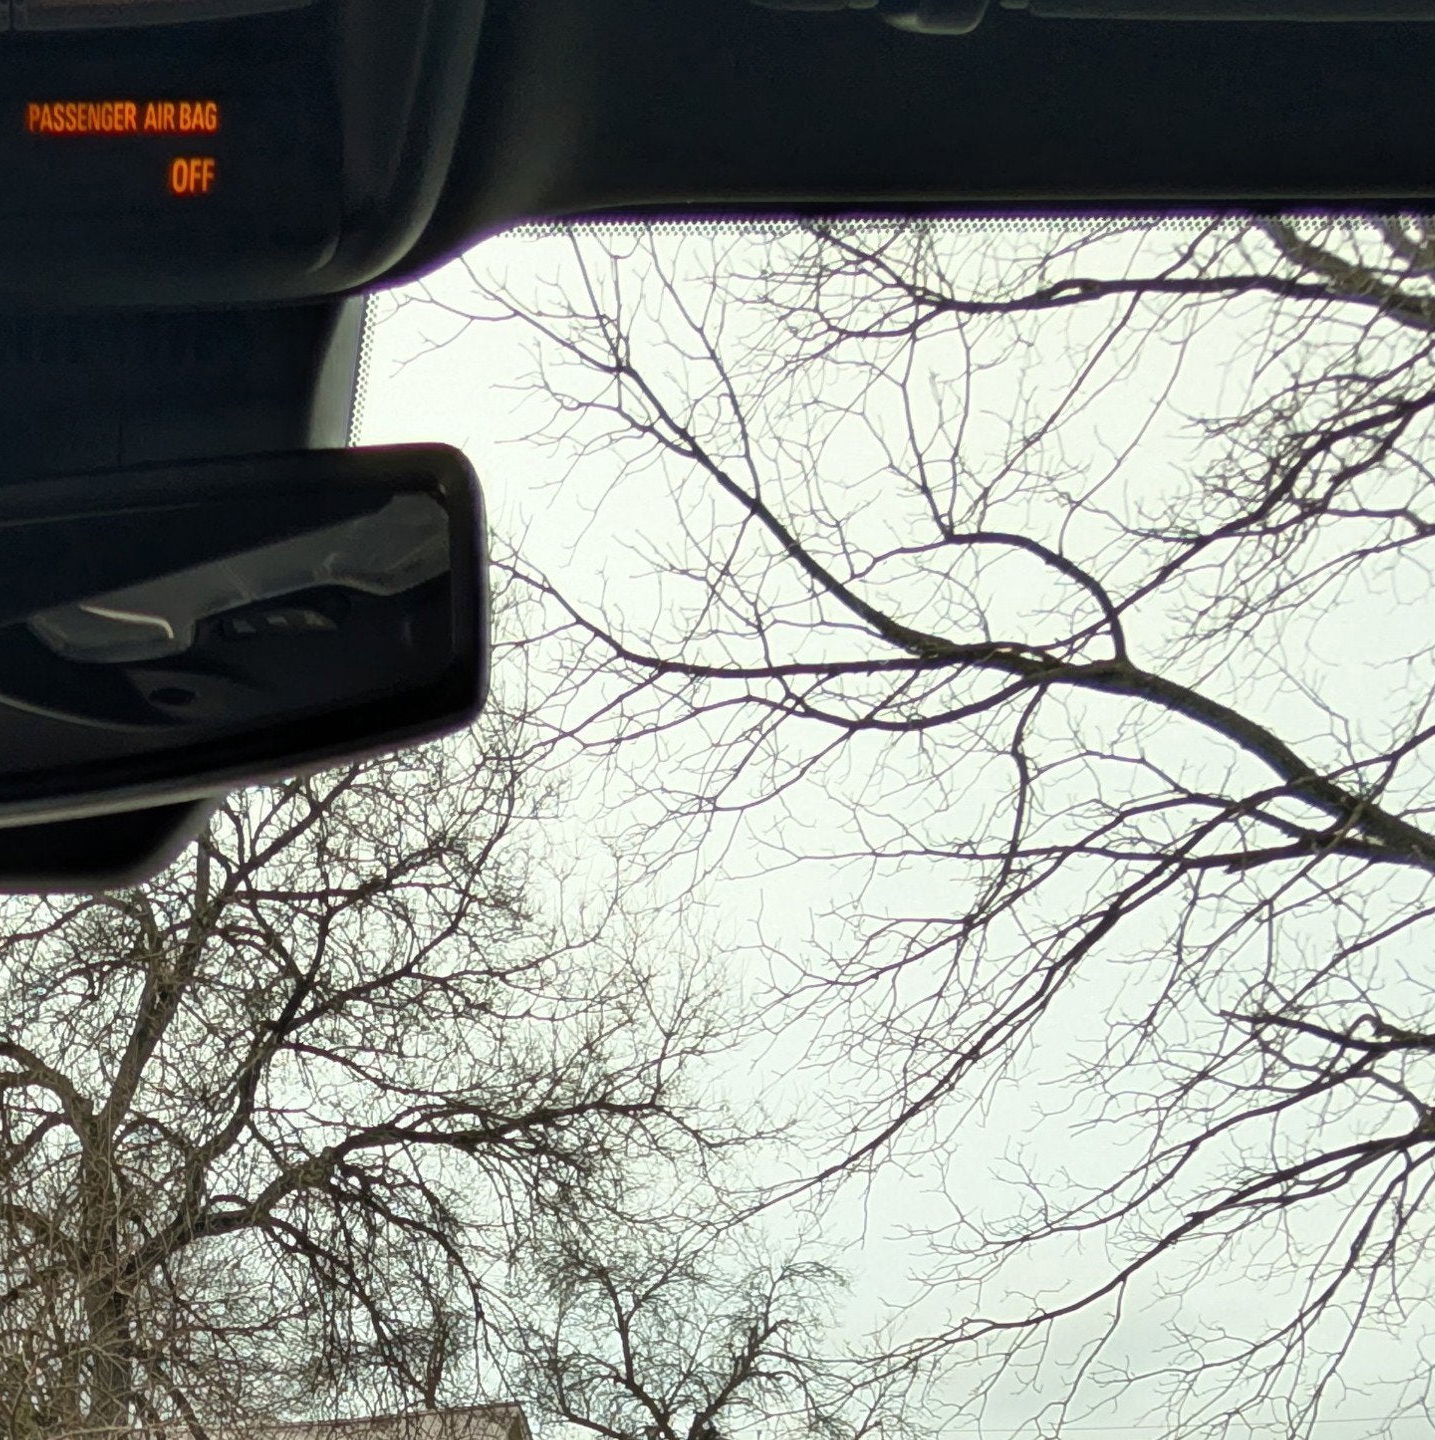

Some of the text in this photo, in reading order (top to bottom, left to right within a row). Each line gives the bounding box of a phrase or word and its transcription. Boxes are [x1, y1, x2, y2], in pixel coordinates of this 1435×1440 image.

[28, 101, 218, 132] PASSENGER AIR BAG
[171, 158, 215, 193] OFF
